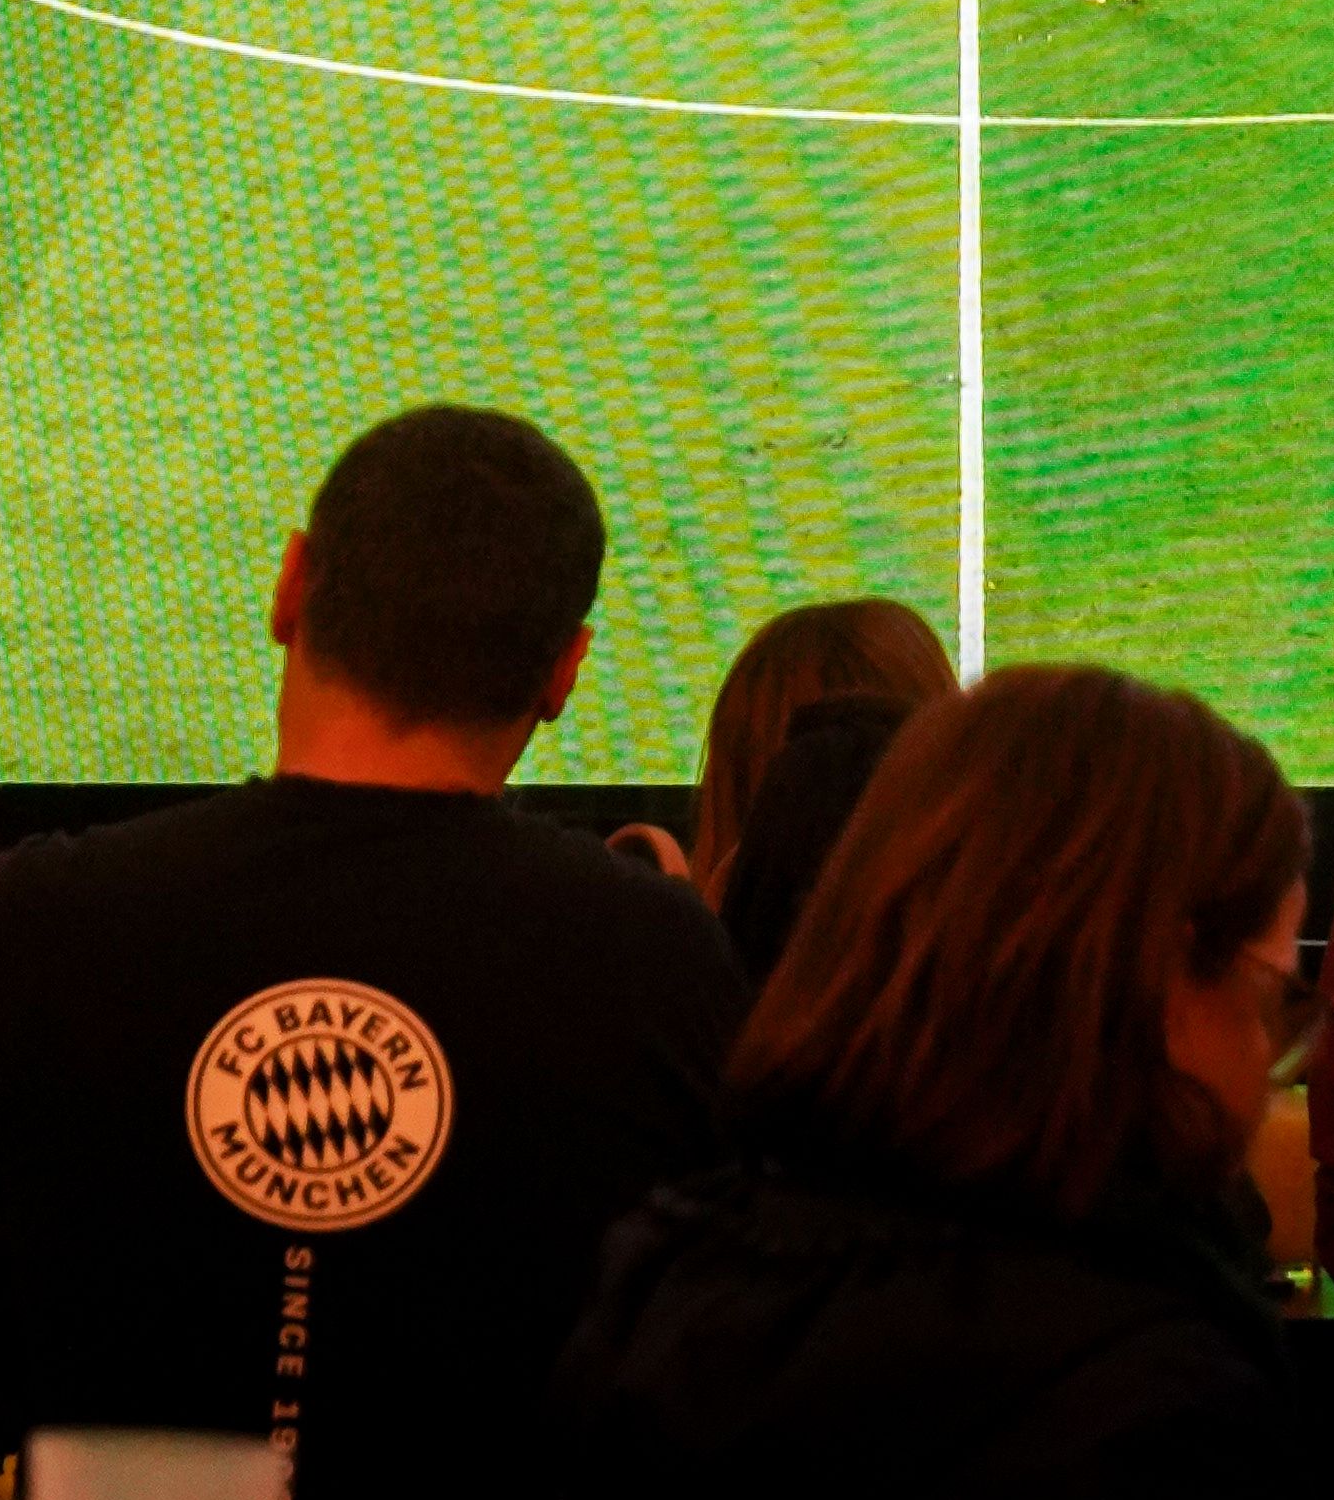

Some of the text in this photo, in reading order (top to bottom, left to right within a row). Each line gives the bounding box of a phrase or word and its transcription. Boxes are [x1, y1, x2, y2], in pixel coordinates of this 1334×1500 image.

[216, 999, 429, 1091] FC BAYERN
[276, 1245, 313, 1376] SINCE
